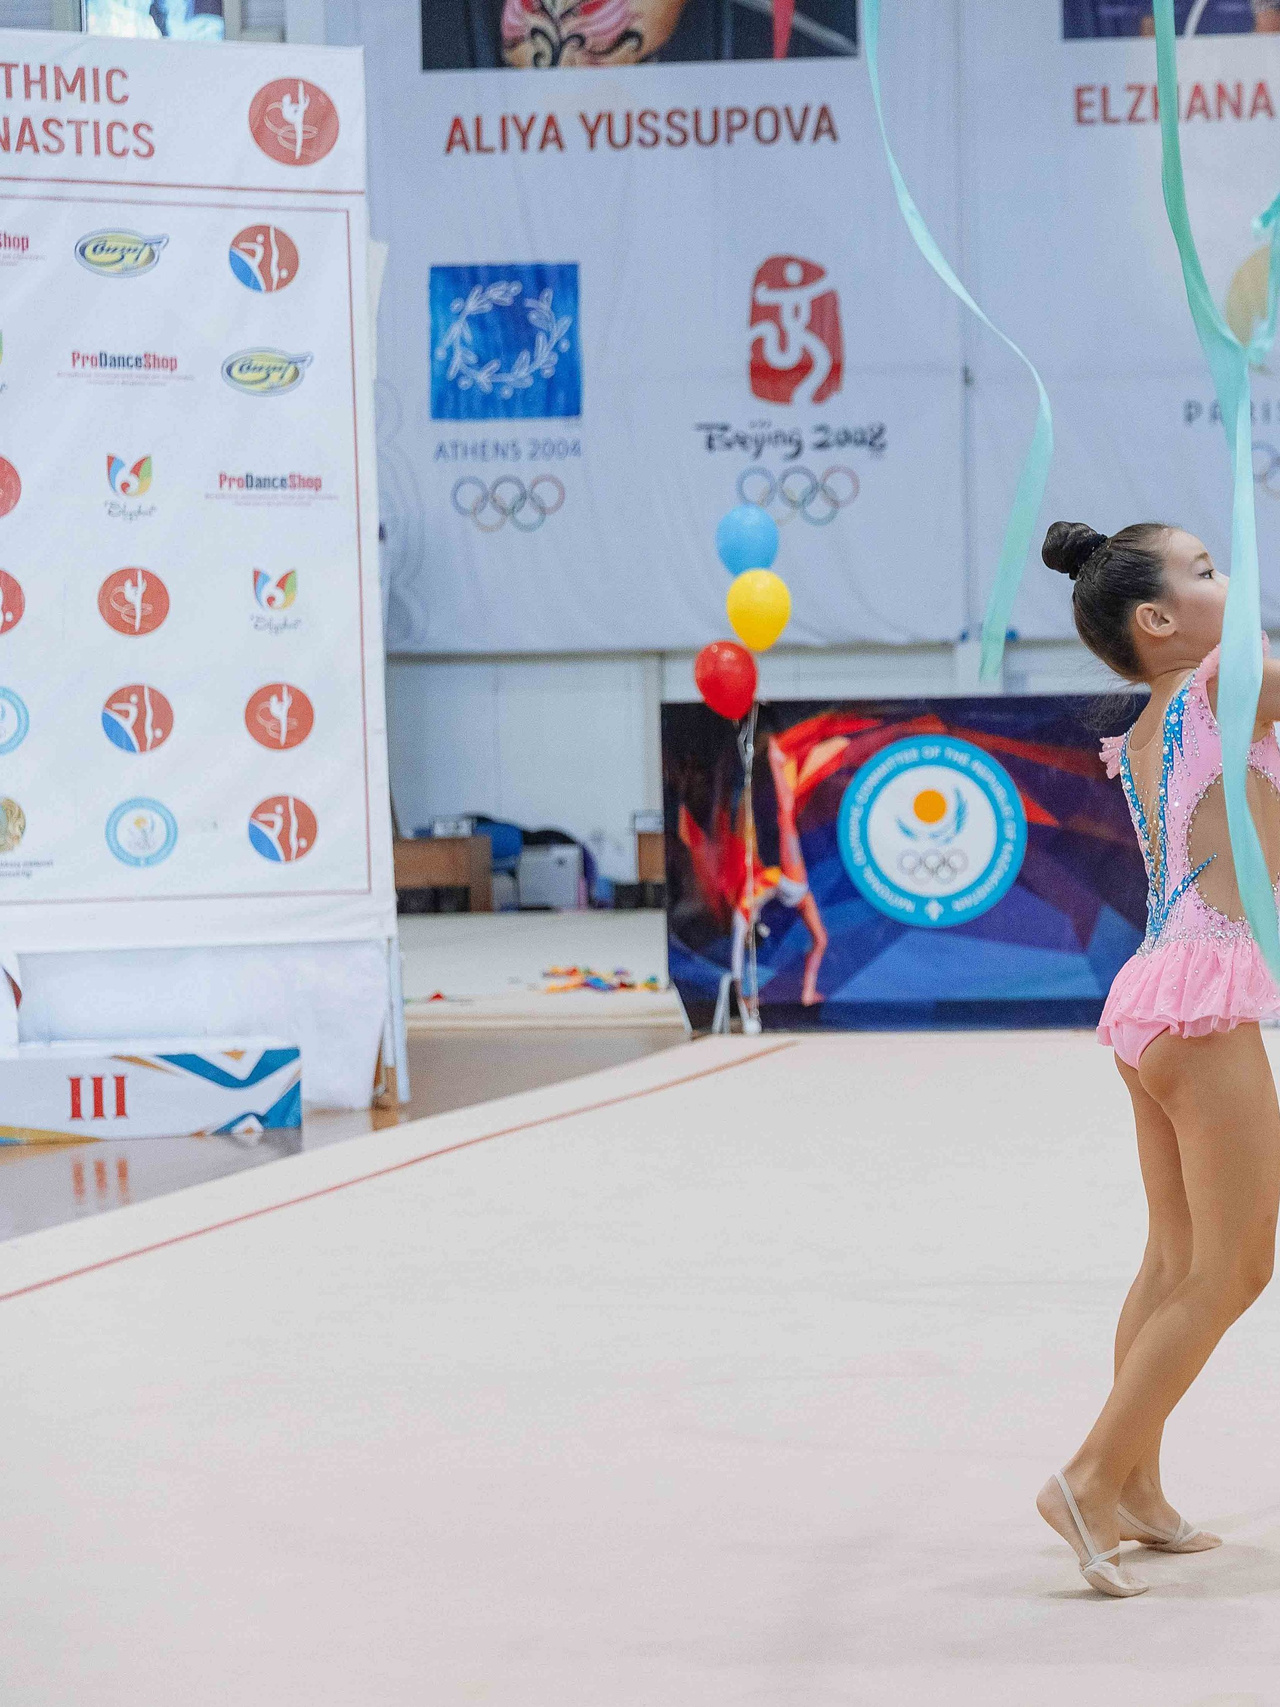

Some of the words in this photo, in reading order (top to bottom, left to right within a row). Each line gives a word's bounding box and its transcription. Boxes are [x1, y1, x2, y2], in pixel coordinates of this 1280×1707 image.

[445, 114, 566, 155] ALIYA
[579, 103, 839, 152] YUSSUPOVA
[71, 350, 178, 373] ProDanceShop
[434, 439, 522, 463] ATHENS
[812, 422, 888, 456] 2008
